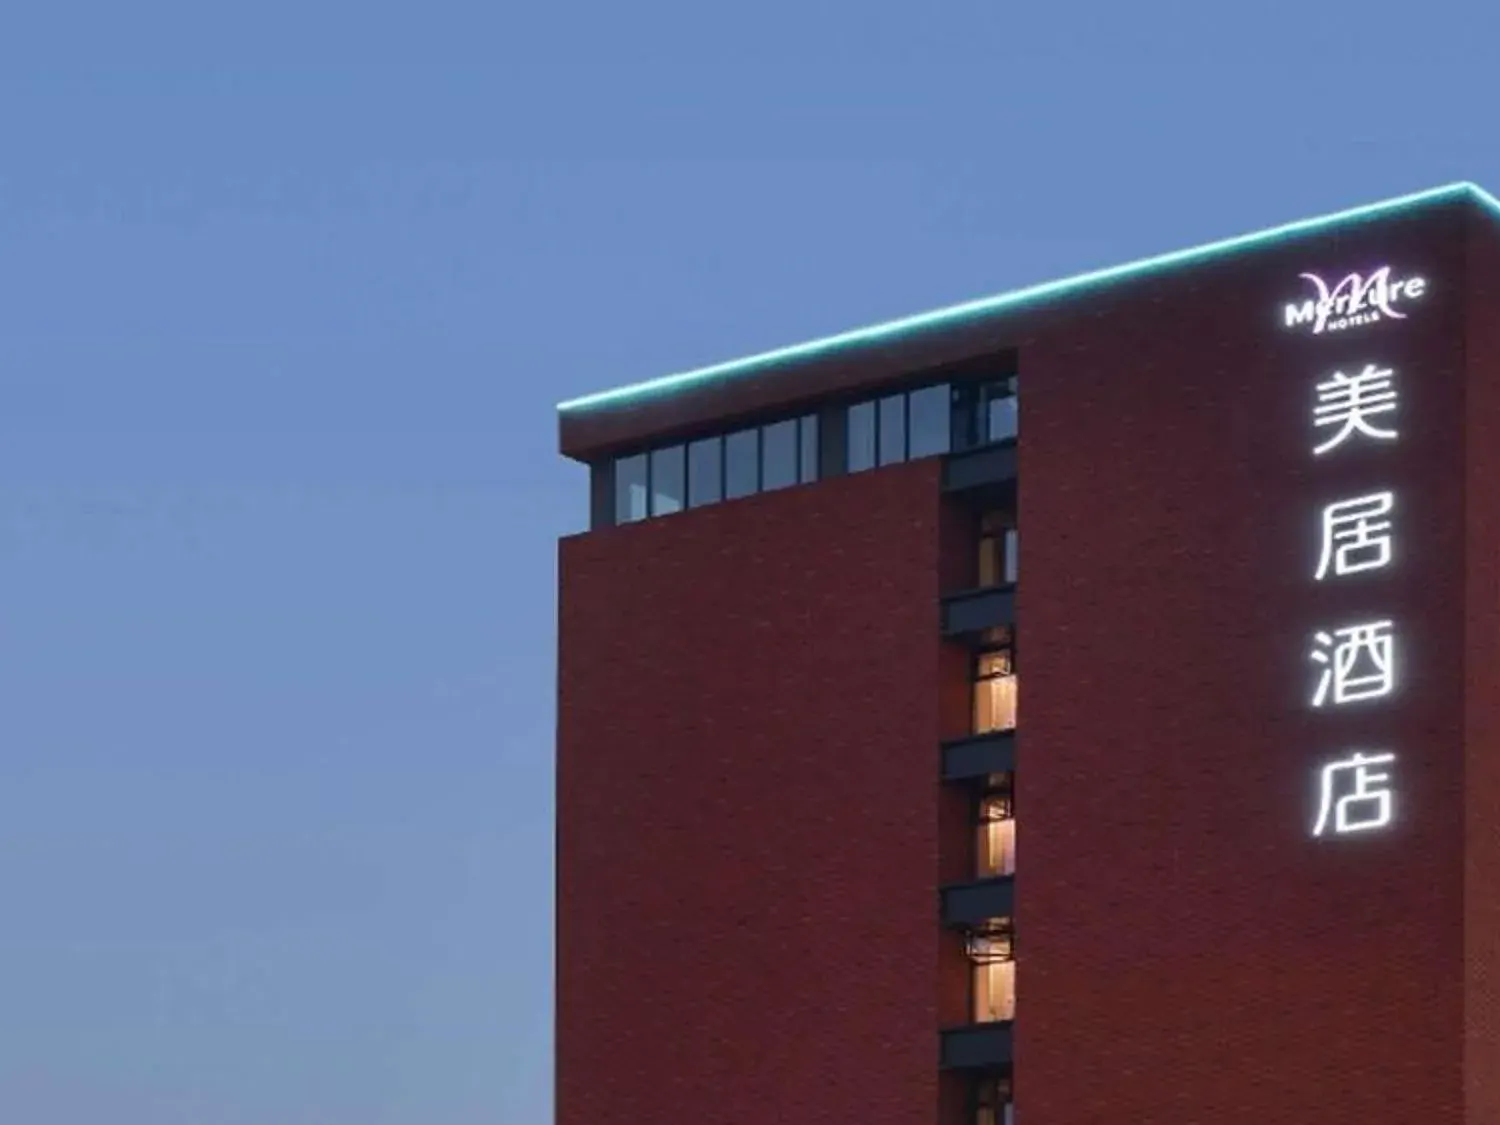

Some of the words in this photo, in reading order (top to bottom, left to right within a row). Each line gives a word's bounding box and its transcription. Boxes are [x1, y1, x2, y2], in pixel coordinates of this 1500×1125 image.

[1327, 311, 1381, 331] HOTELS
[1310, 363, 1398, 837] 美居酒店
